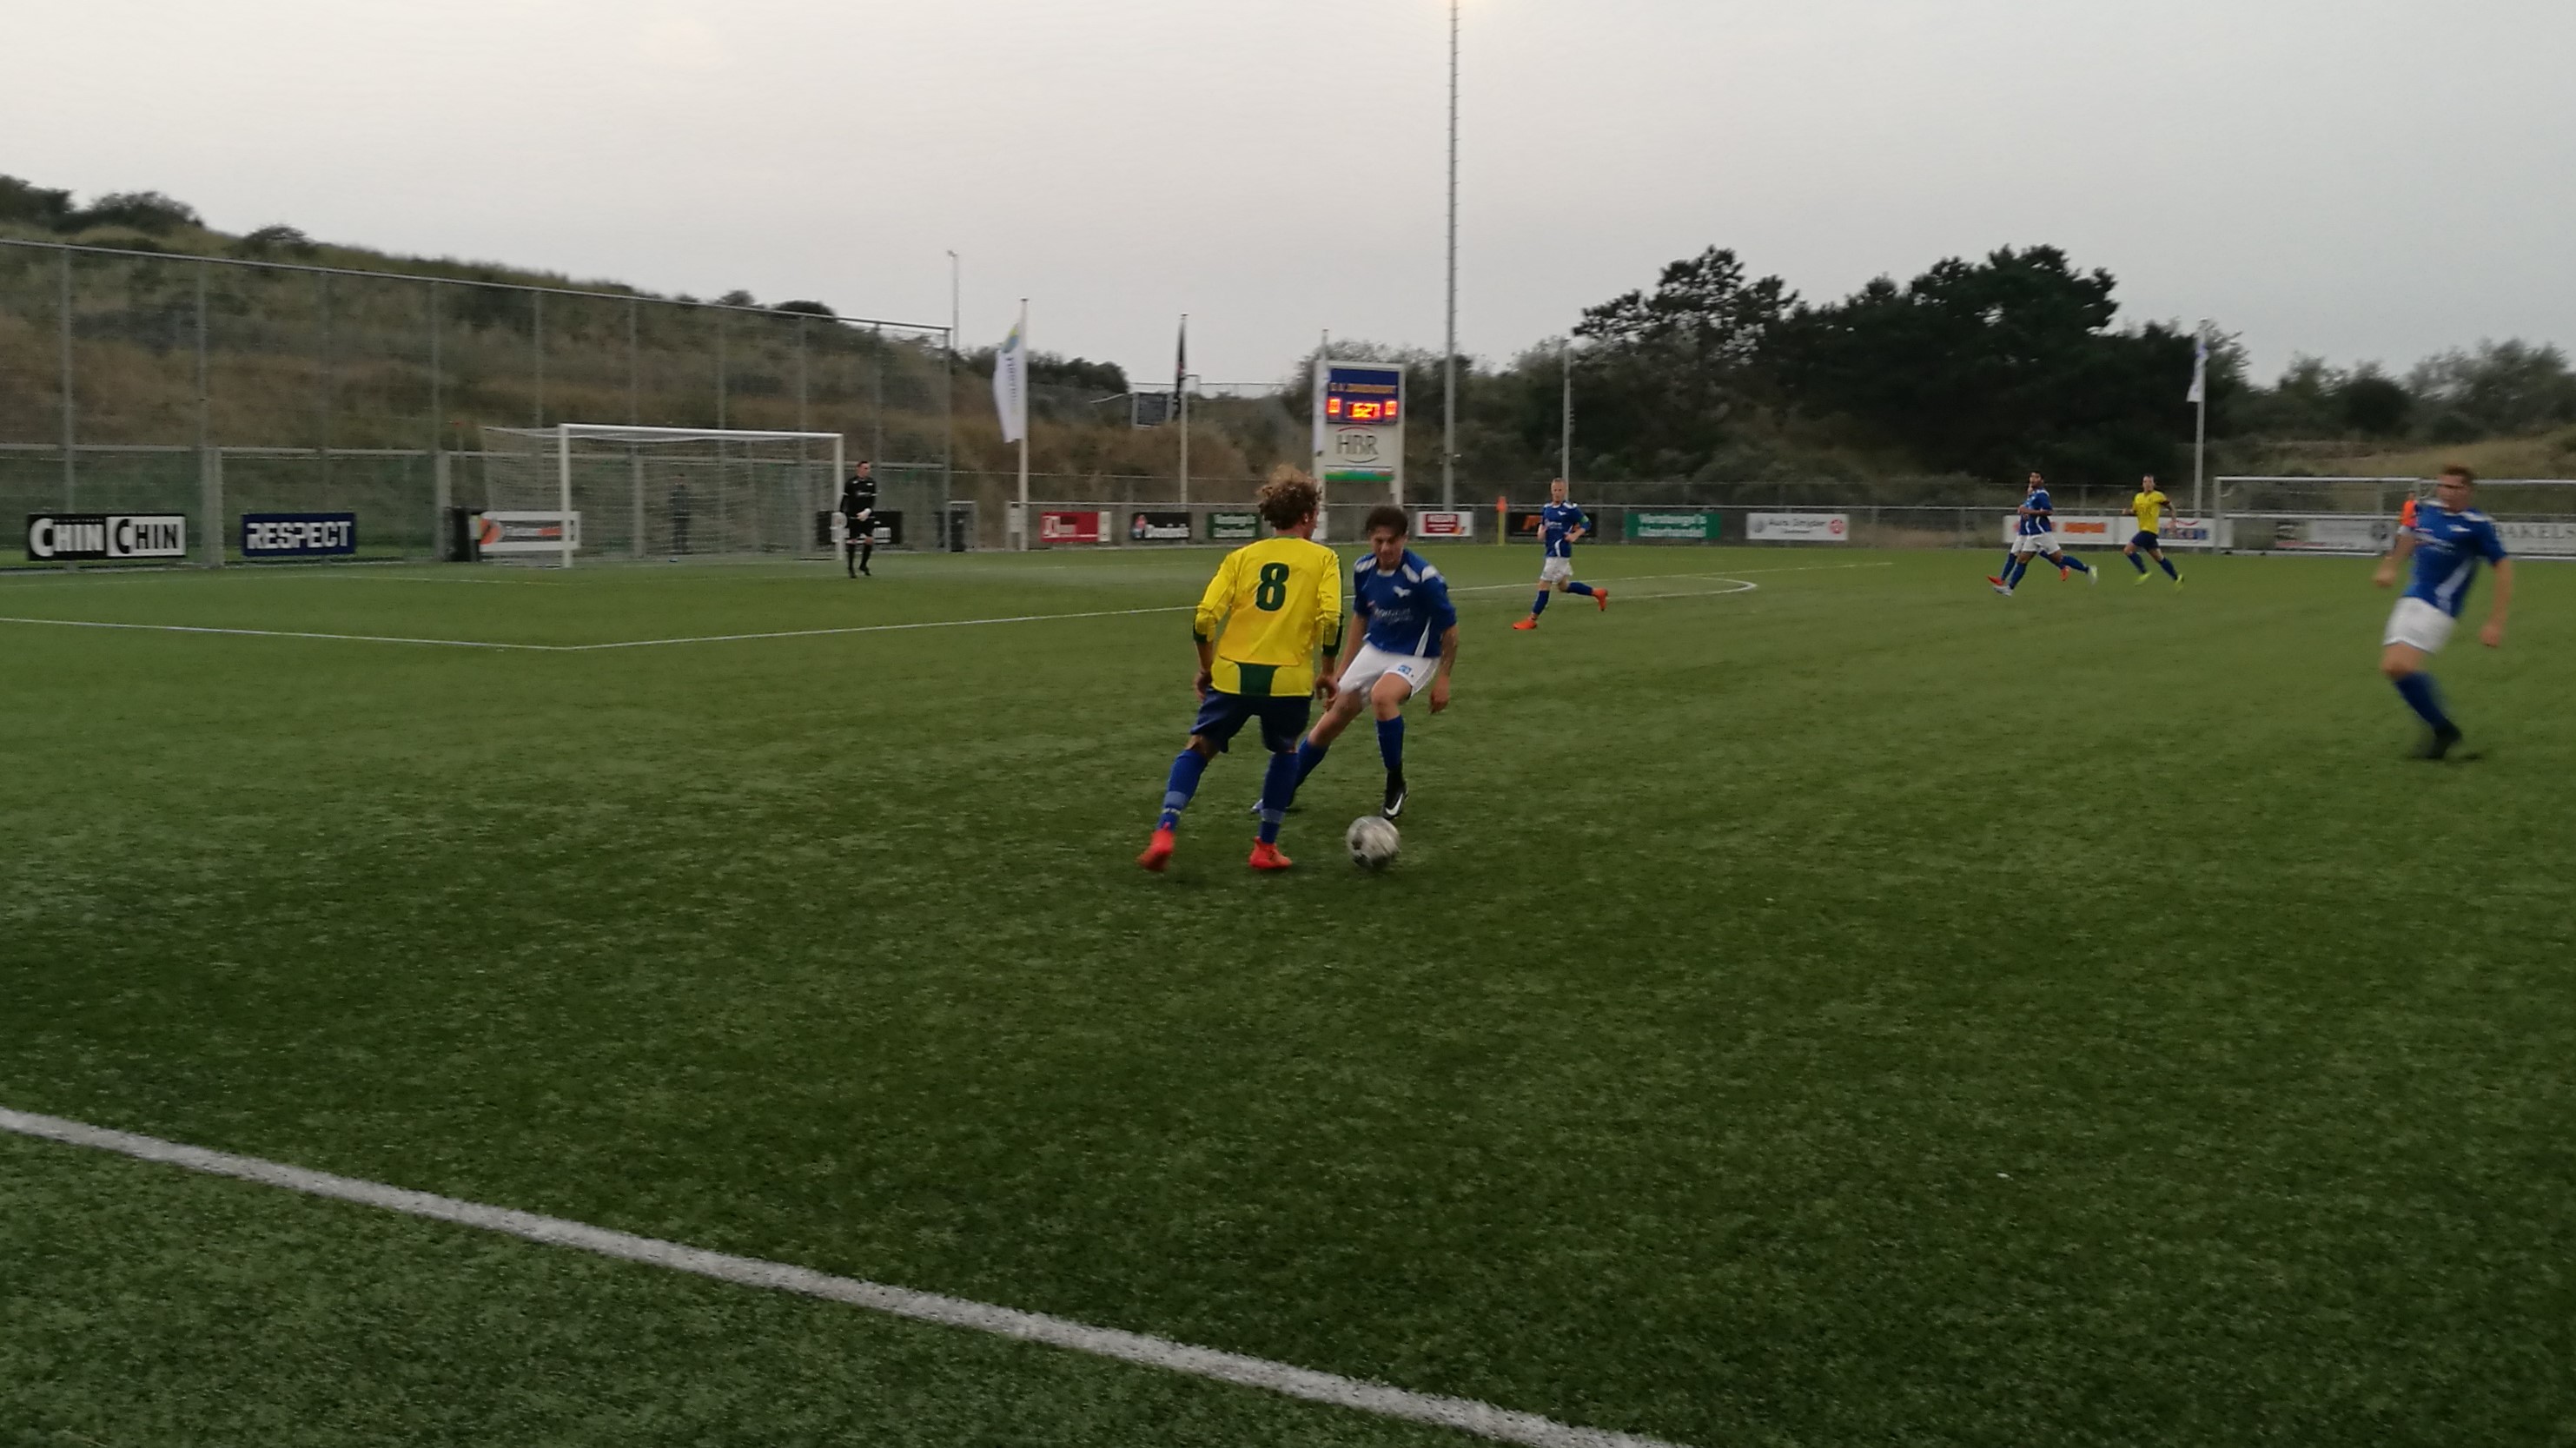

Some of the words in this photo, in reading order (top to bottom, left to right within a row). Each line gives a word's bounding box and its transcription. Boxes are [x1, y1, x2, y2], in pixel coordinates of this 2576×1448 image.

[1336, 434, 1379, 455] HBR
[29, 518, 104, 557] CHIN
[116, 519, 178, 554] CHIN
[247, 521, 352, 549] RESPECT
[1255, 561, 1289, 612] 8
